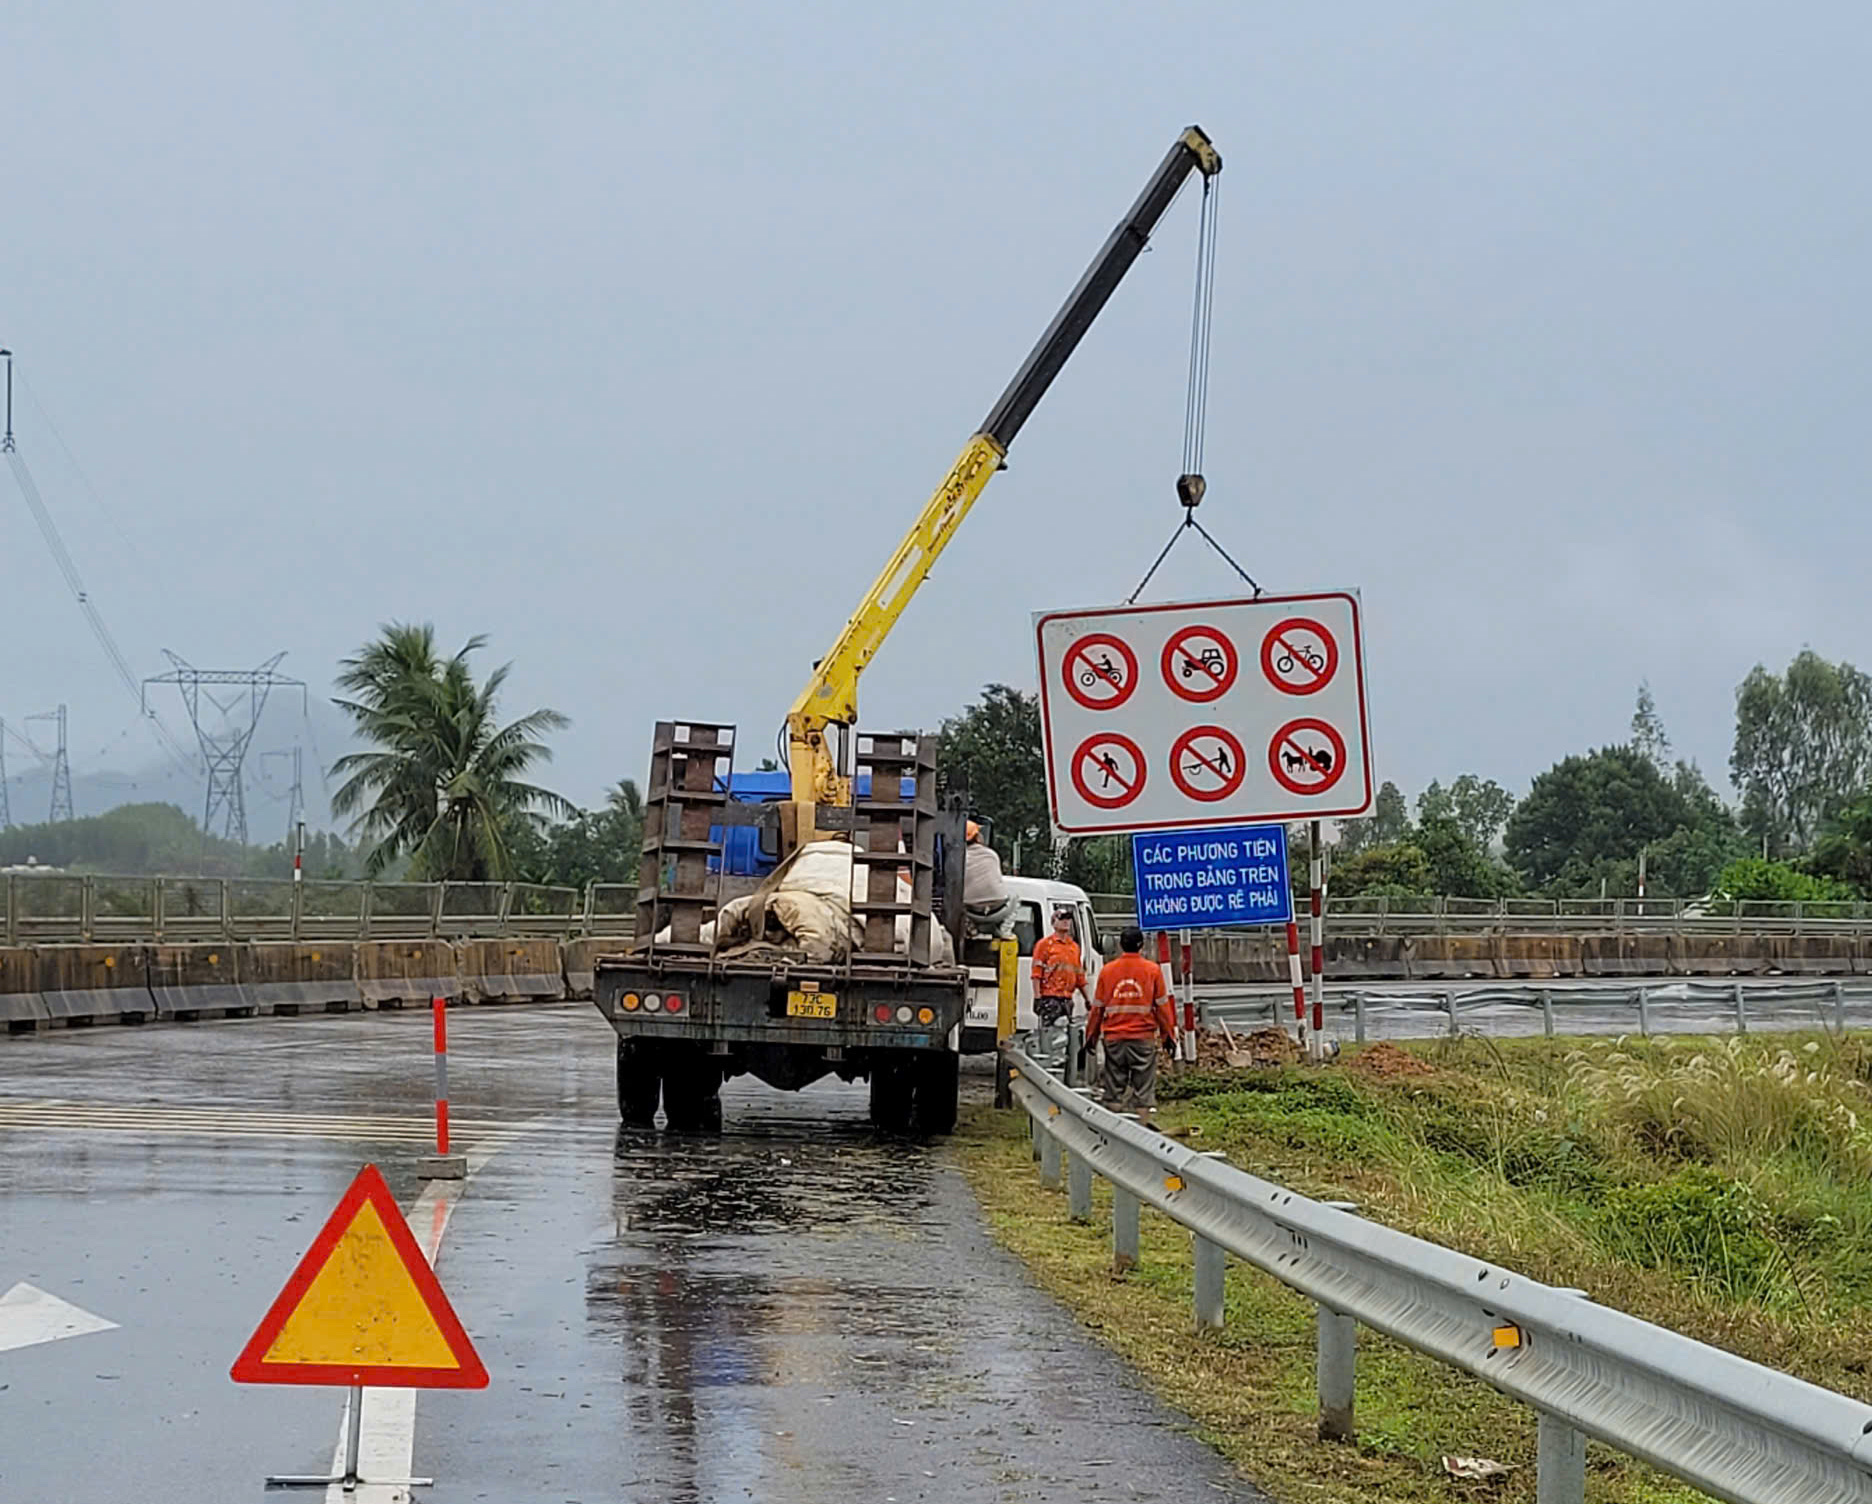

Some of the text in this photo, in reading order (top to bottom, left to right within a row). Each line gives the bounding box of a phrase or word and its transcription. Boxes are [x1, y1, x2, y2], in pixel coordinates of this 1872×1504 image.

[1143, 838, 1277, 864] CÁC PHƯƠNG TIỆN
[1145, 864, 1279, 891] TRONG BẢNG TRÊN
[1145, 894, 1187, 915] KHÔNG
[1191, 893, 1223, 913] ĐƯỢC
[1249, 885, 1278, 908] PHẢI
